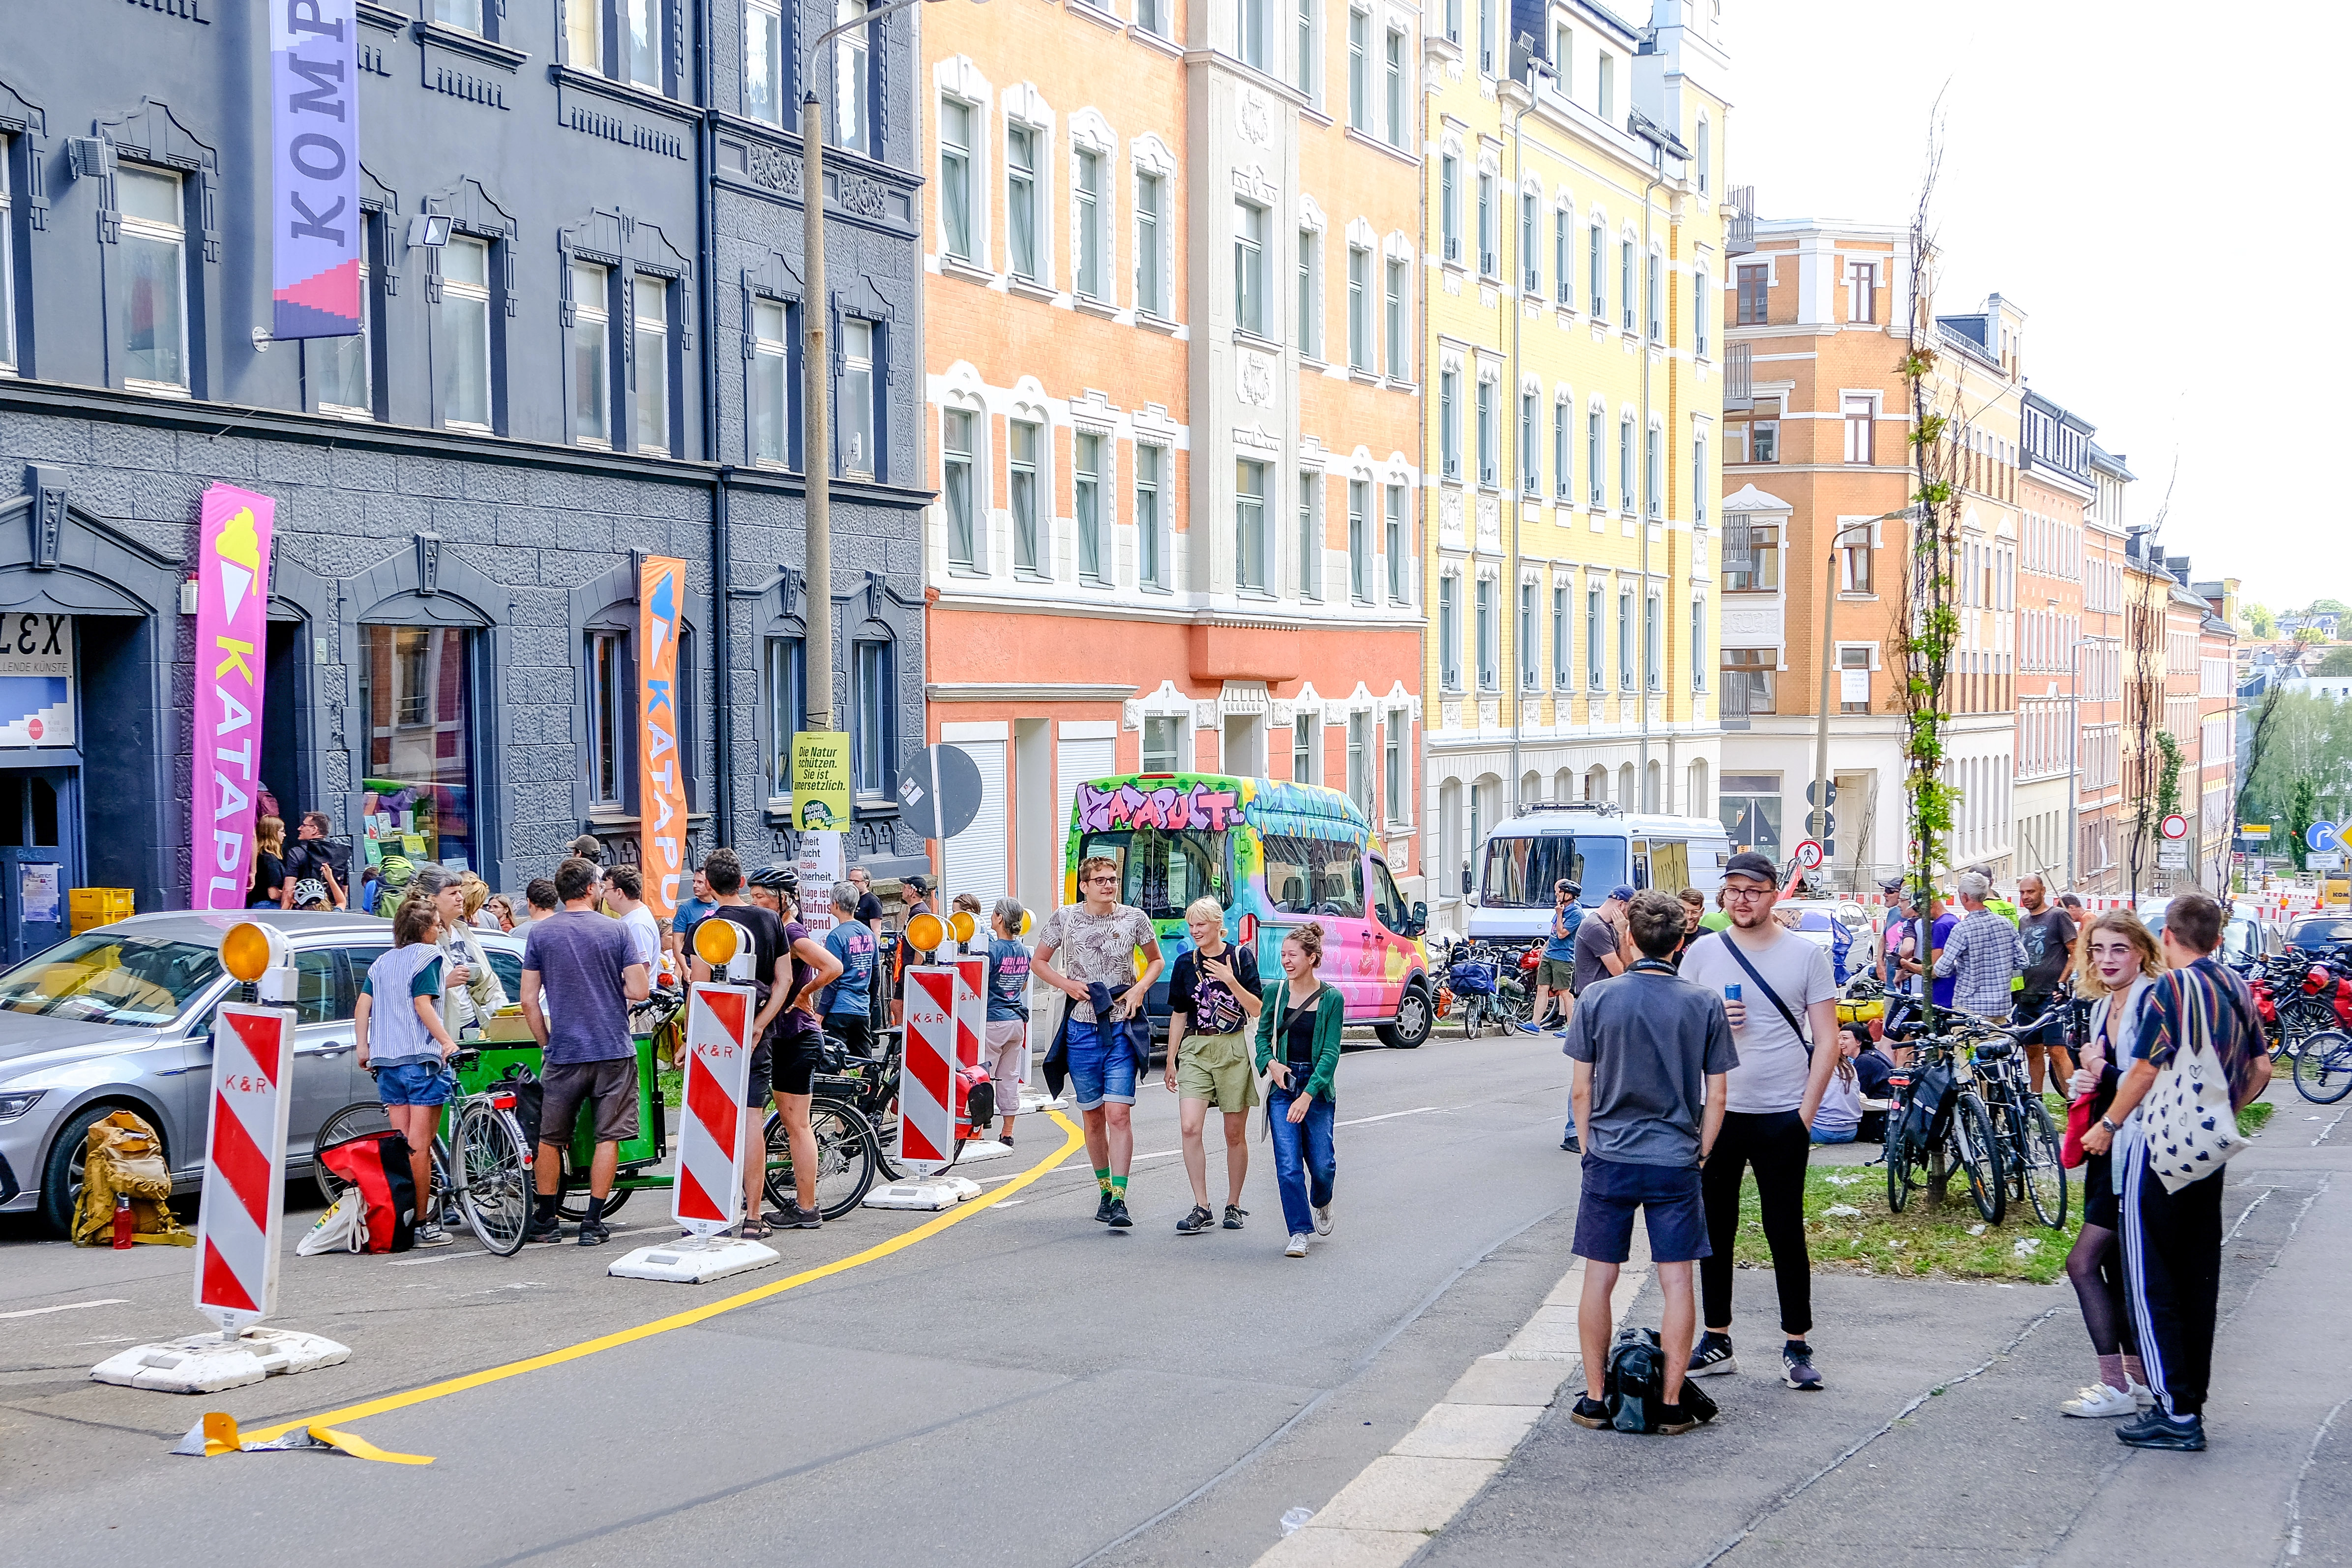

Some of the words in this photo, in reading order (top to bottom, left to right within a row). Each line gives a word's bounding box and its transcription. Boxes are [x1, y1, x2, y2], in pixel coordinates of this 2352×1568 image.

[33, 660, 68, 672] KÜNSTE
[799, 746, 809, 757] Die
[810, 746, 837, 757] Natur
[798, 757, 837, 768] schützen.
[803, 768, 815, 779] Sie
[816, 769, 830, 779] ist
[794, 779, 846, 791] unersetzlich.
[804, 802, 824, 814] Richtig
[805, 810, 828, 821] wichtig.
[805, 886, 817, 900] Lage
[820, 887, 830, 898] ist
[960, 992, 967, 1001] &
[969, 992, 975, 1001] R
[913, 1013, 921, 1023] K
[924, 1013, 932, 1023] &
[936, 1013, 944, 1024] R
[698, 1043, 707, 1055] K
[711, 1045, 719, 1056] &
[724, 1046, 732, 1058] R
[226, 1074, 236, 1090] K
[240, 1076, 251, 1092] &
[256, 1078, 266, 1094] R
